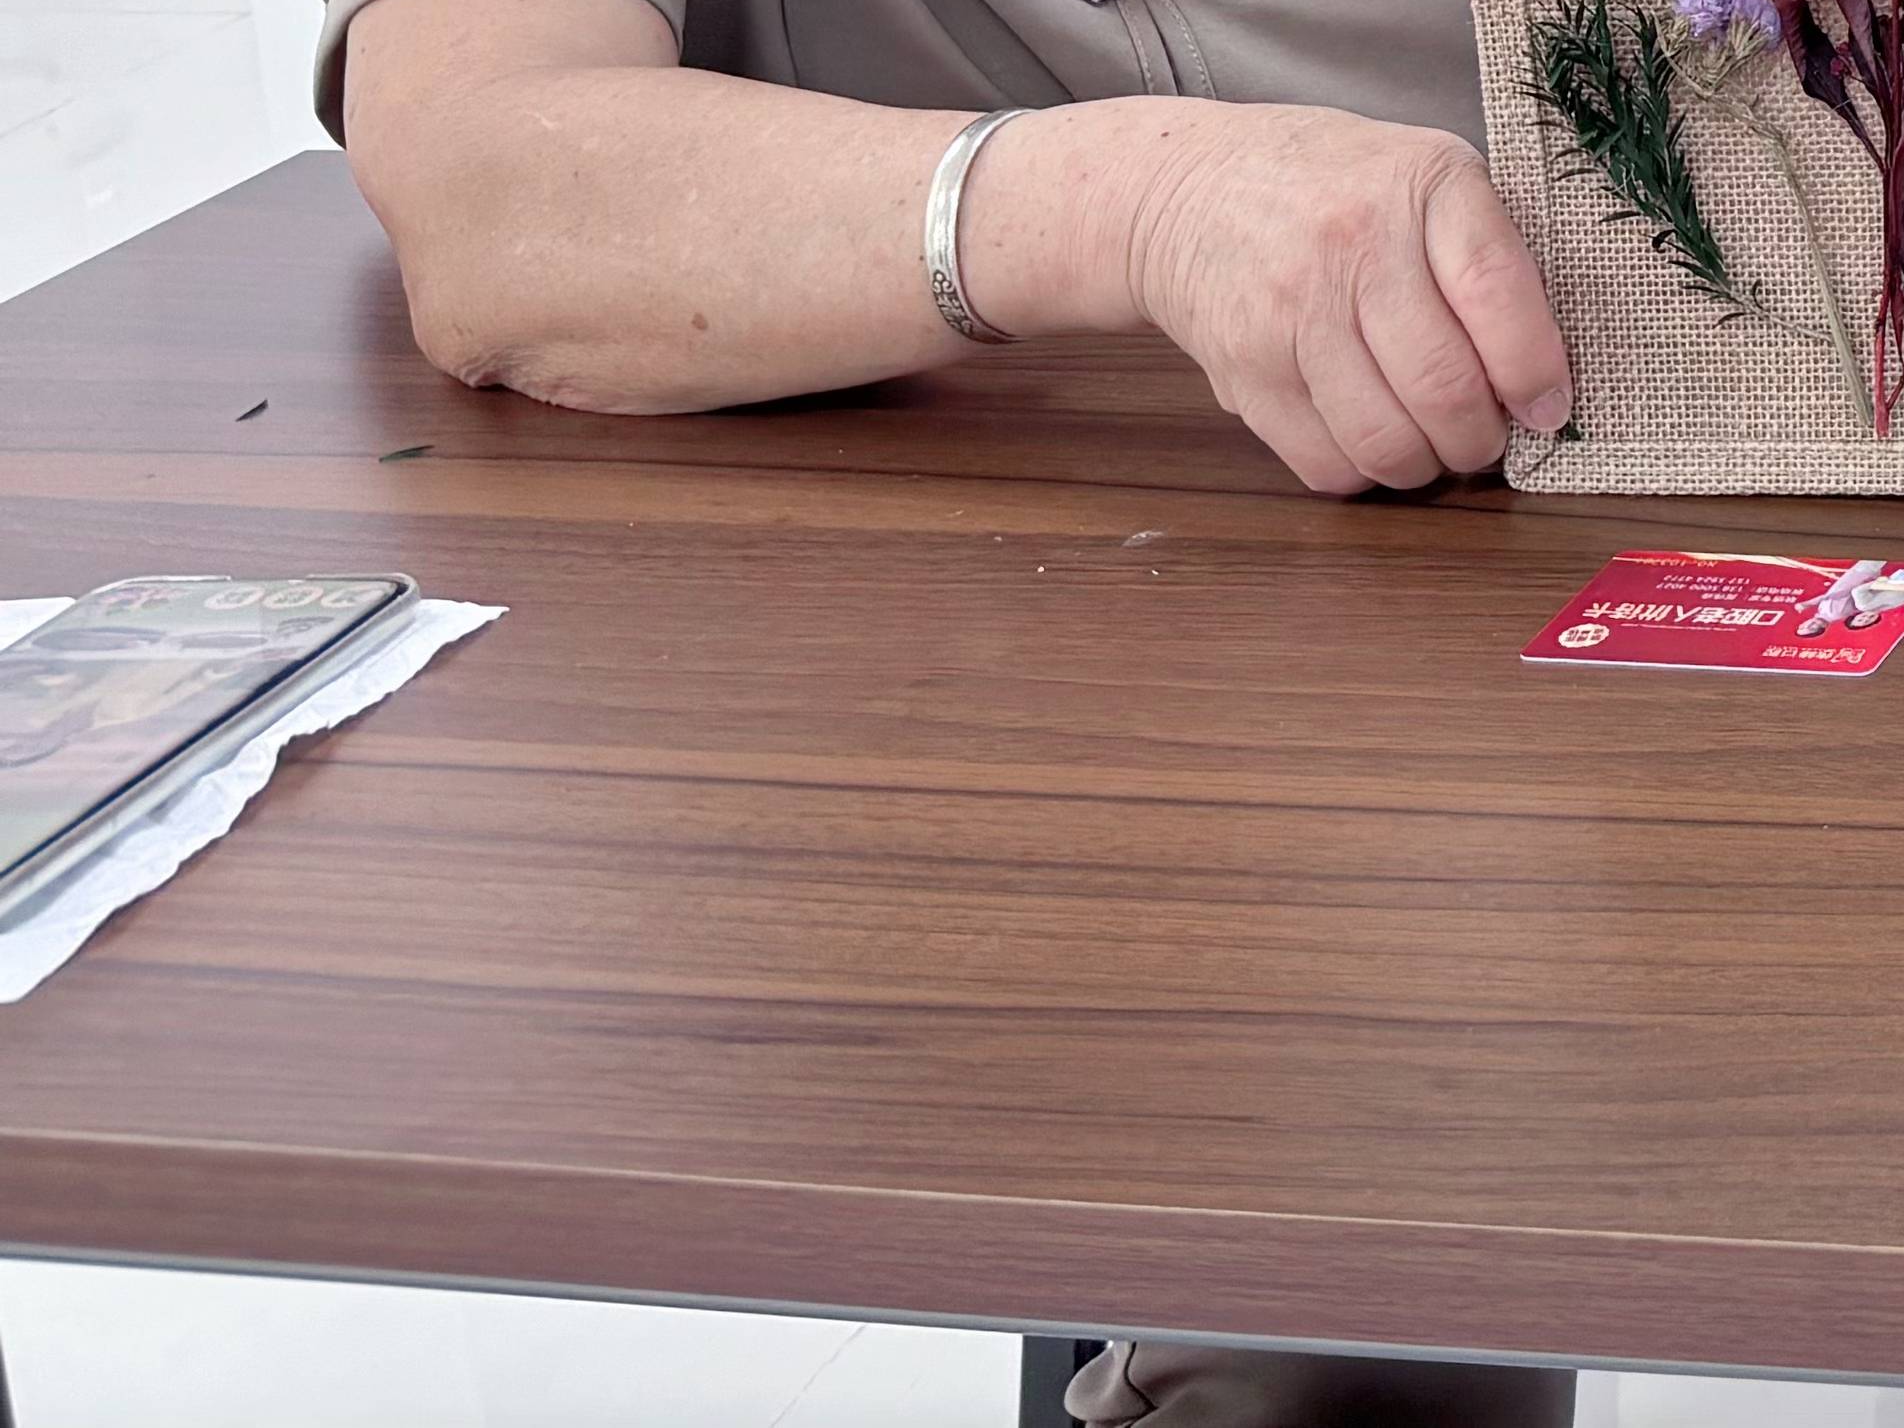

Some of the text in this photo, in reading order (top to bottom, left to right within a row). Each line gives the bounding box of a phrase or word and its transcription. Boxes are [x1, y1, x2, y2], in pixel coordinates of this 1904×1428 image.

[1582, 602, 1785, 626] 口腔老人优待卡
